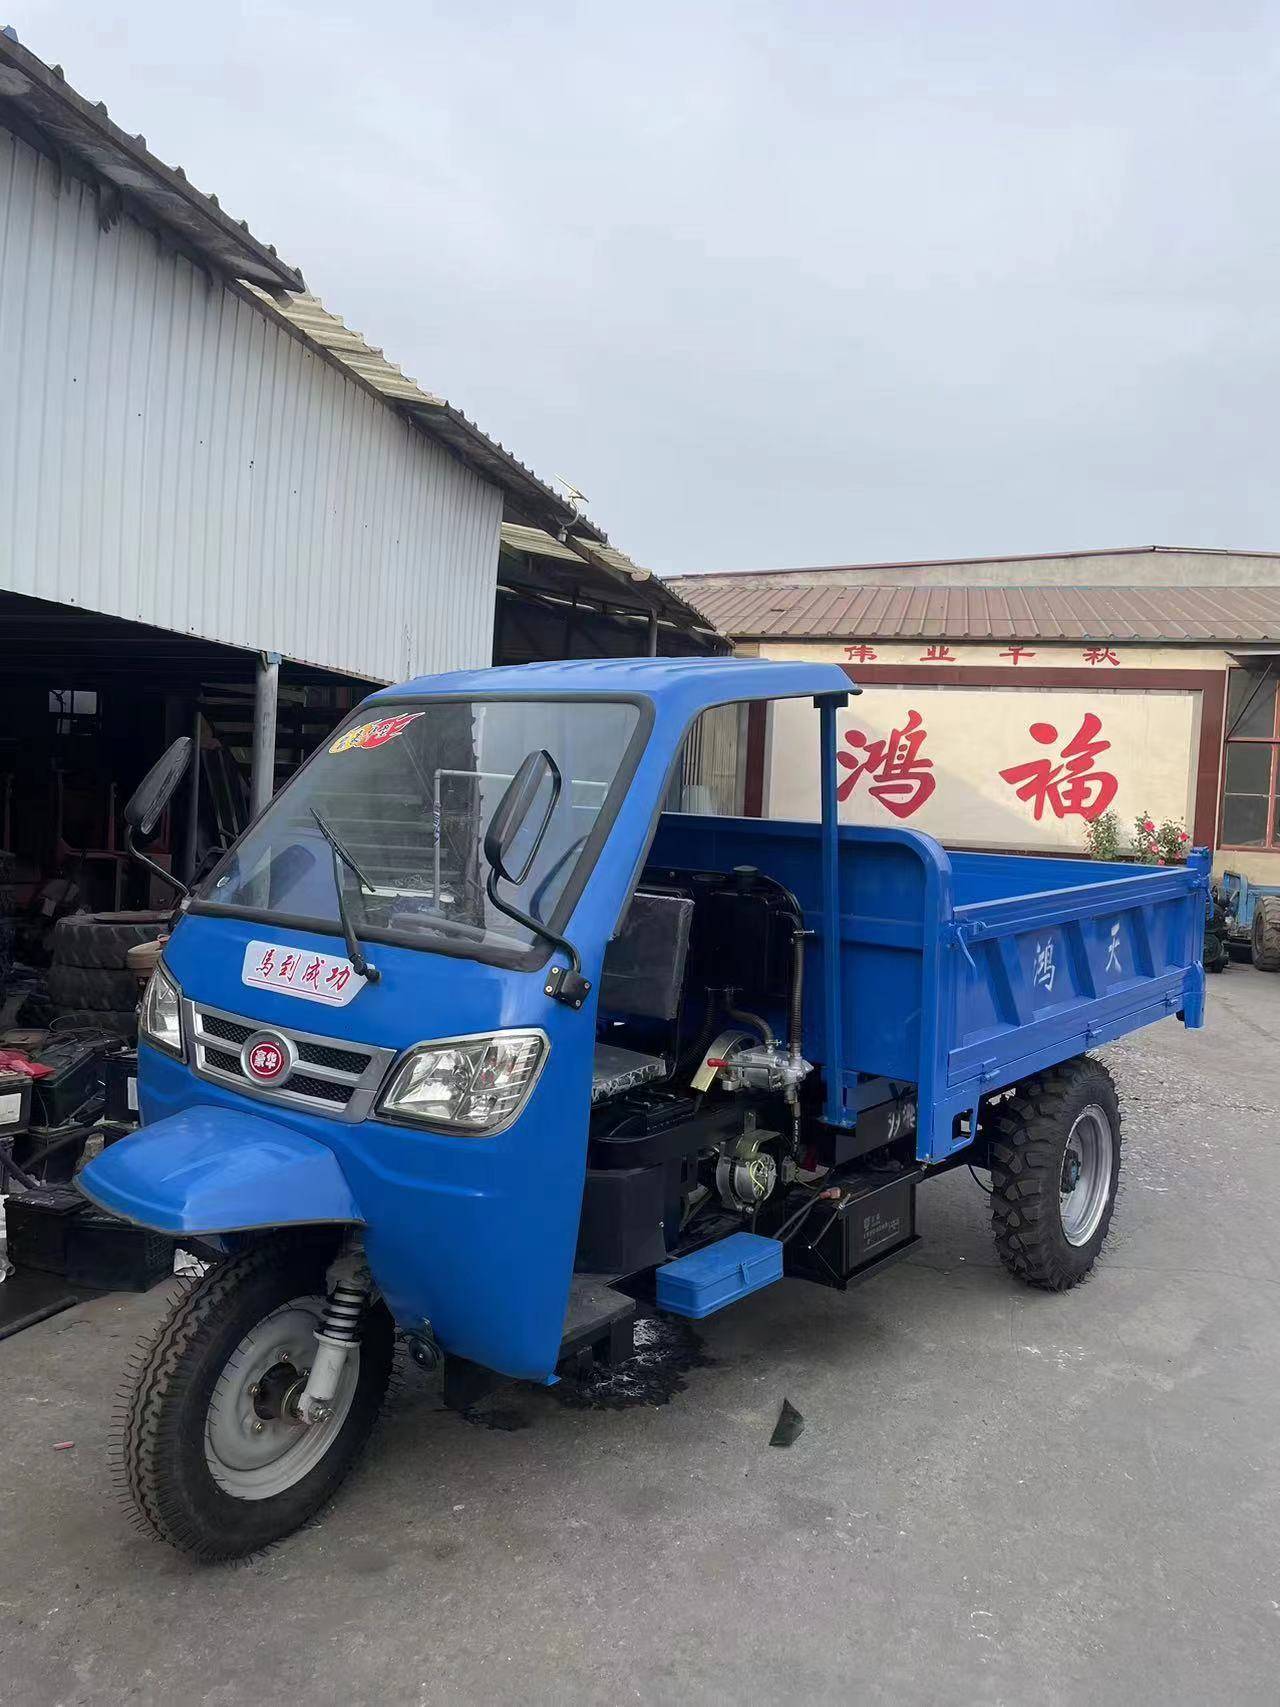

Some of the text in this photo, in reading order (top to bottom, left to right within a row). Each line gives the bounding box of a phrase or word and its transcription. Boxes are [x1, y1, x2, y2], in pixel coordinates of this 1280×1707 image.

[844, 645, 1121, 666] 伟业千秋
[837, 709, 1119, 821] 鸿福
